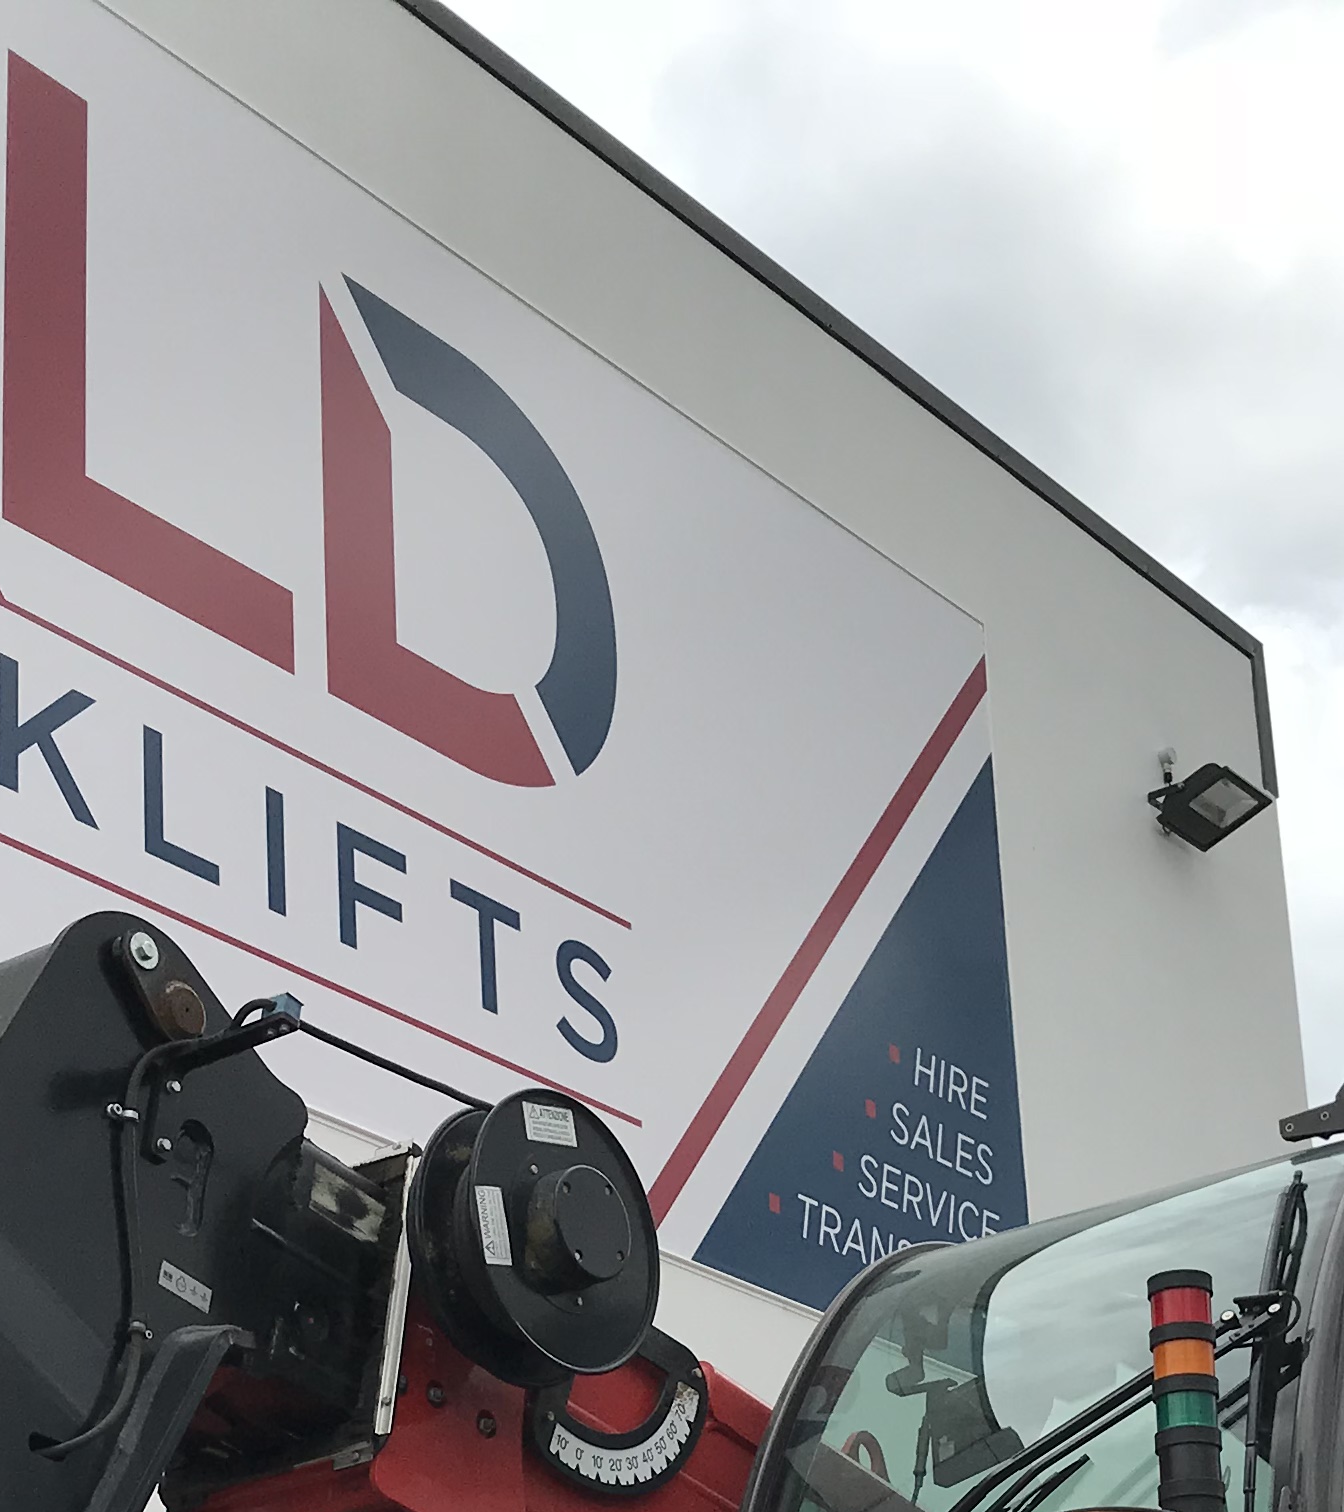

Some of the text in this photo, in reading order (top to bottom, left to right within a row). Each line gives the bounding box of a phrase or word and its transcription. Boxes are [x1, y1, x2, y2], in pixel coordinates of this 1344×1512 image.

[914, 1047, 990, 1121] HIRE
[890, 1102, 994, 1185] SALES
[477, 1189, 492, 1240] WARNING
[797, 1193, 914, 1265] TRAN
[858, 1154, 1001, 1242] SERVICE
